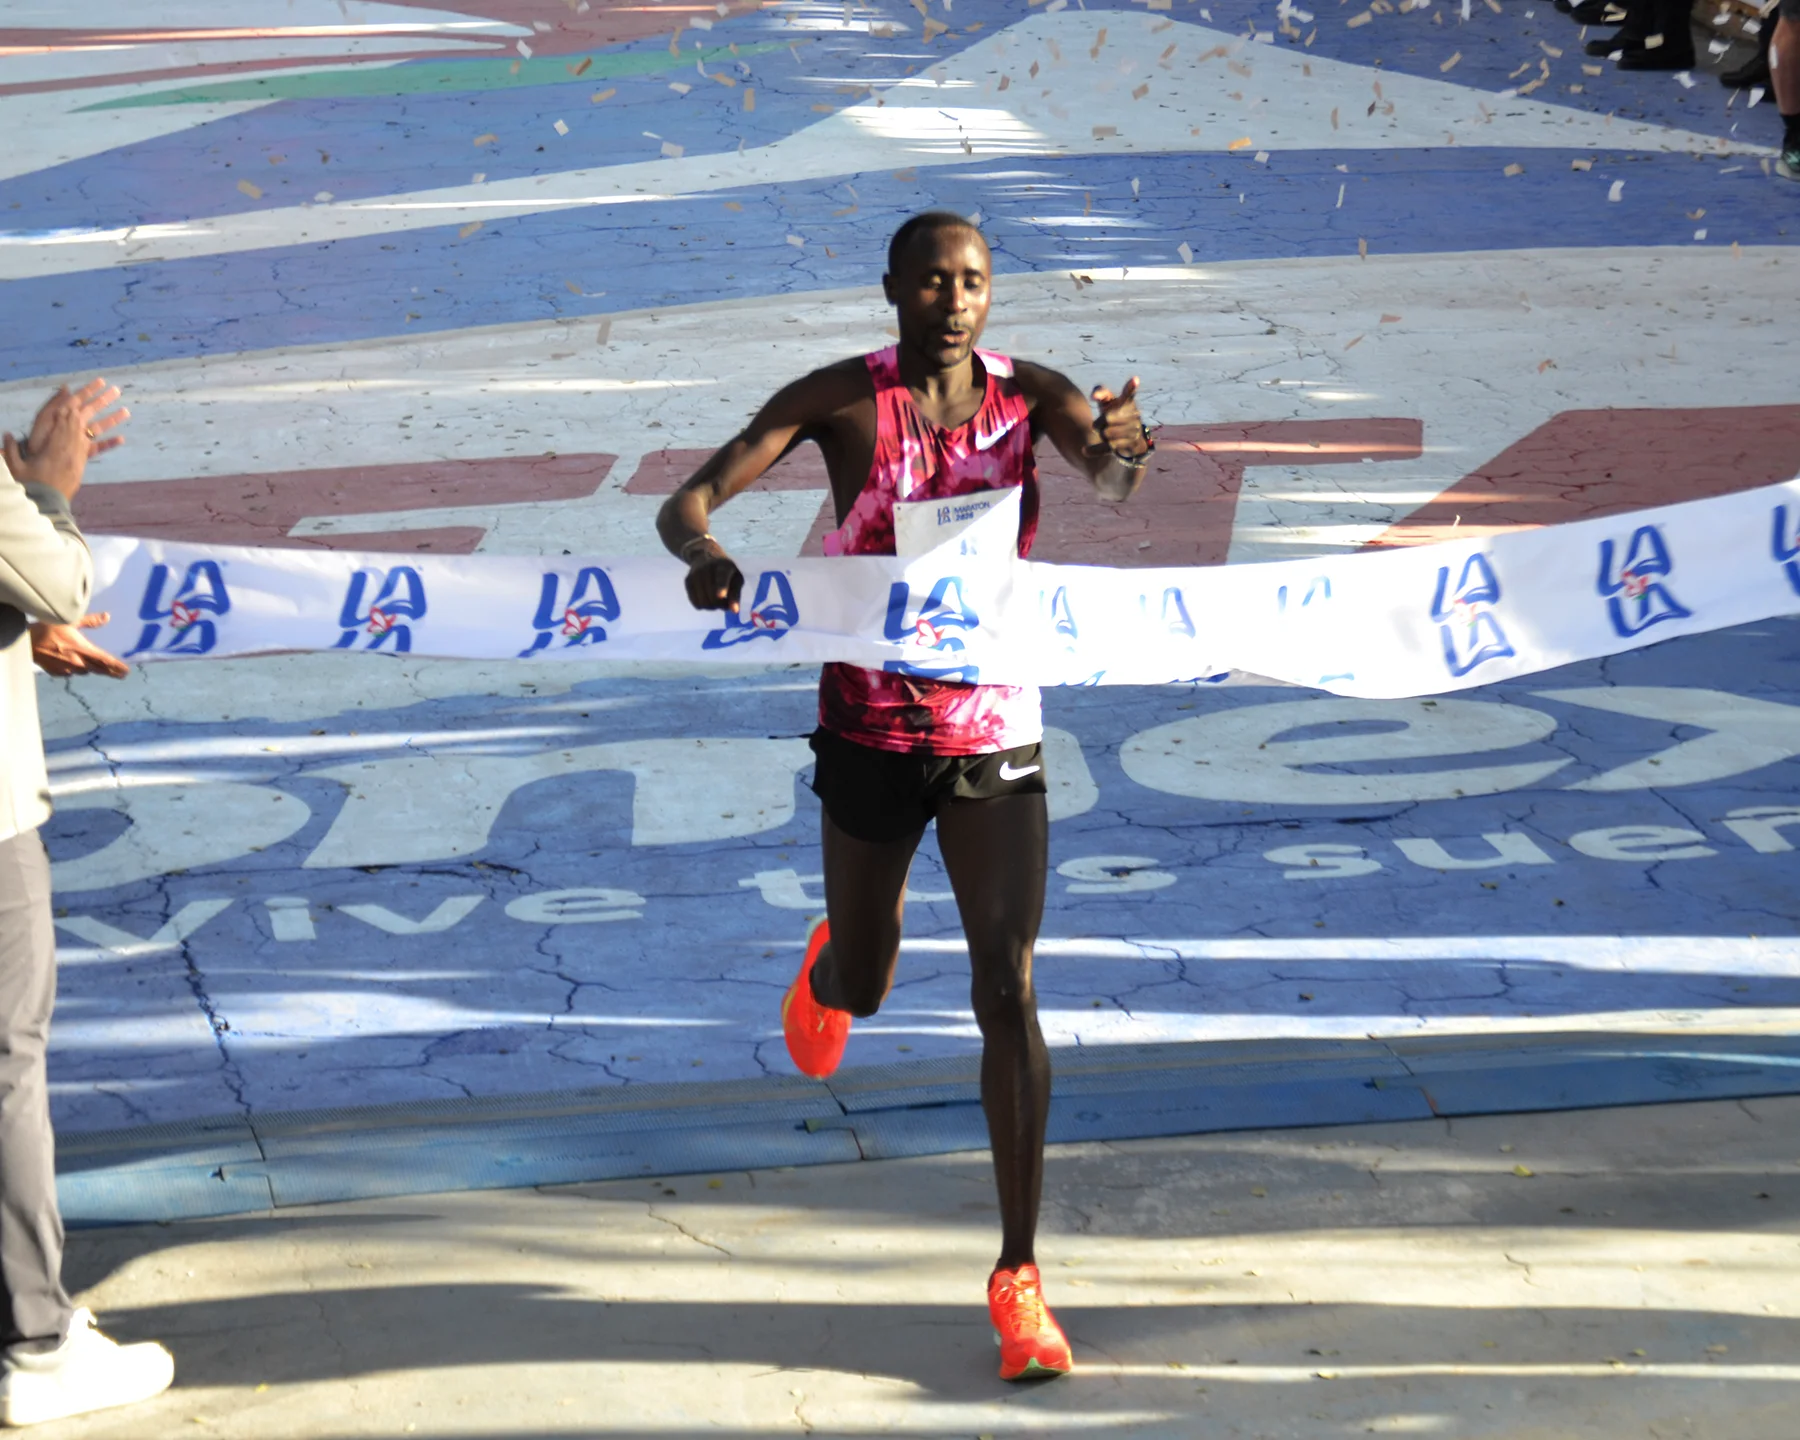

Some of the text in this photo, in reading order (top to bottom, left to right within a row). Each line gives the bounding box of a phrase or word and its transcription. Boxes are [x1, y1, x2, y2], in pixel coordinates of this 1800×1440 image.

[139, 560, 230, 620] LA
[1431, 552, 1501, 622] LA
[1597, 525, 1672, 596] LA
[339, 566, 426, 628] LA
[533, 566, 621, 629] LA
